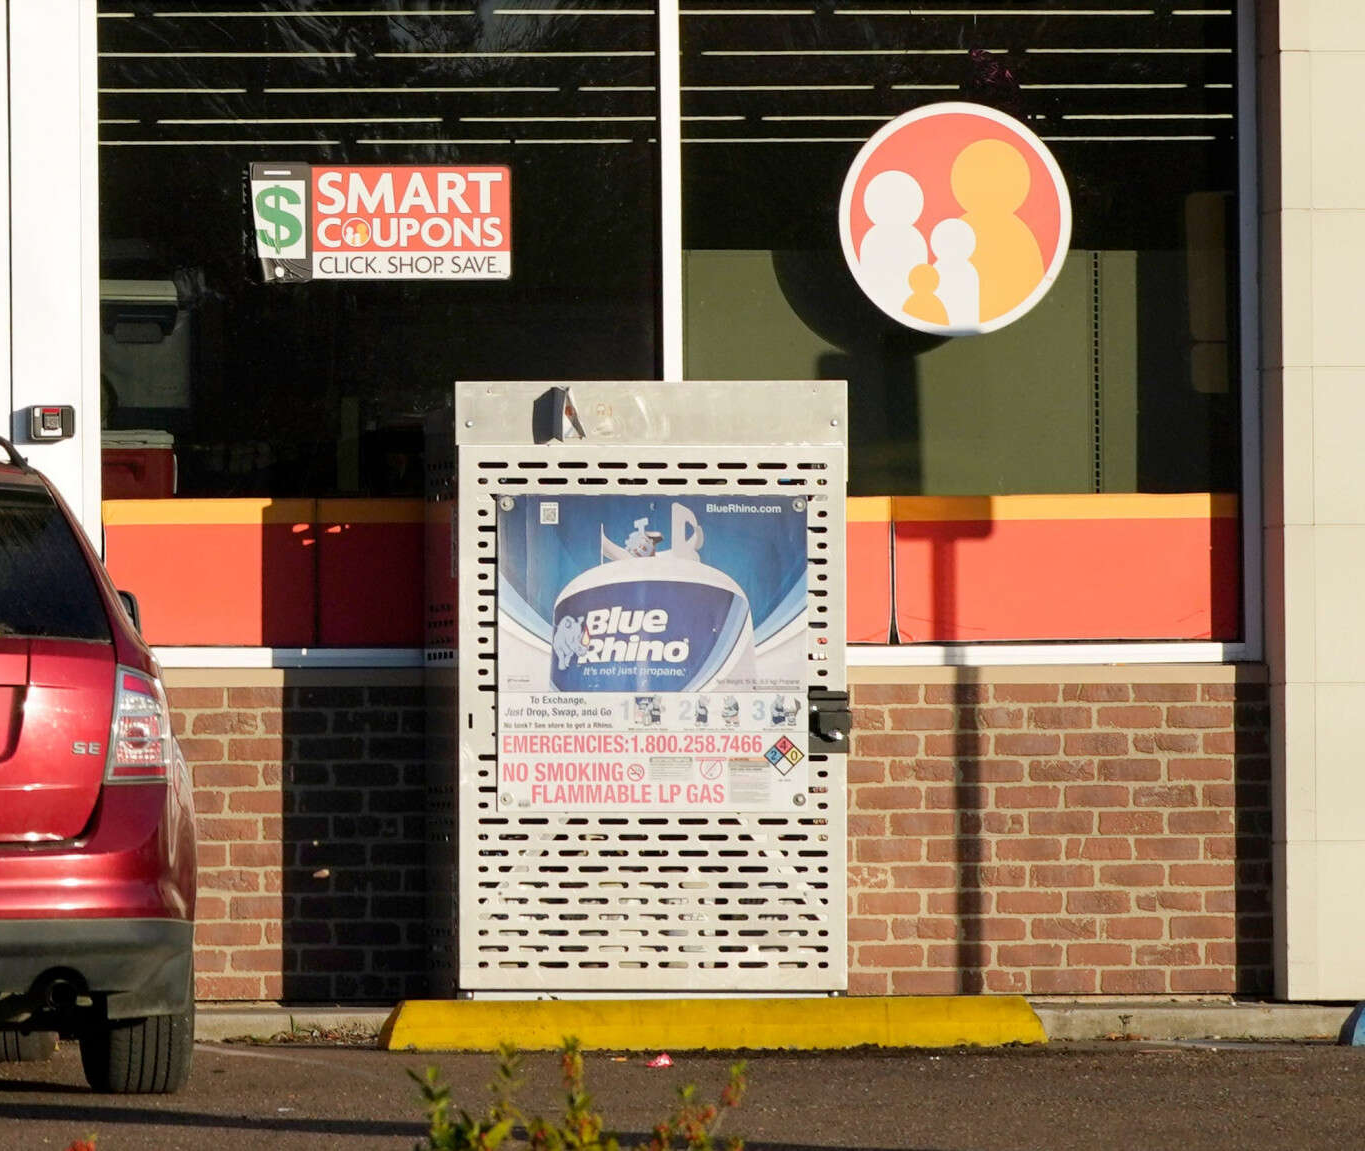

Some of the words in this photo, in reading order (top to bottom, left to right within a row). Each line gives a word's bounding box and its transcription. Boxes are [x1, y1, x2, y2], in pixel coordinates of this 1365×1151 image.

[316, 171, 503, 215] SMART
[317, 216, 504, 248] COUPONS
[319, 256, 382, 275] CLICK.
[387, 255, 444, 275] SHOP.
[451, 255, 502, 275] SAVE.
[706, 503, 782, 513] BlueRhino.com
[585, 607, 669, 635] Blue
[583, 666, 597, 676] It's
[599, 666, 615, 676] not
[617, 666, 637, 677] just
[530, 695, 540, 704] To
[542, 695, 587, 705] Exchange,
[505, 707, 524, 717] Just
[526, 707, 549, 717] Drop,
[551, 707, 579, 717] Swap,
[581, 707, 598, 716] and
[600, 707, 612, 716] Go
[72, 741, 101, 755] SE
[502, 762, 529, 782] NO
[534, 762, 624, 782] SMOKING
[531, 783, 652, 804] FLAMMABLE
[658, 783, 681, 804] LP
[686, 783, 725, 804] GAS
